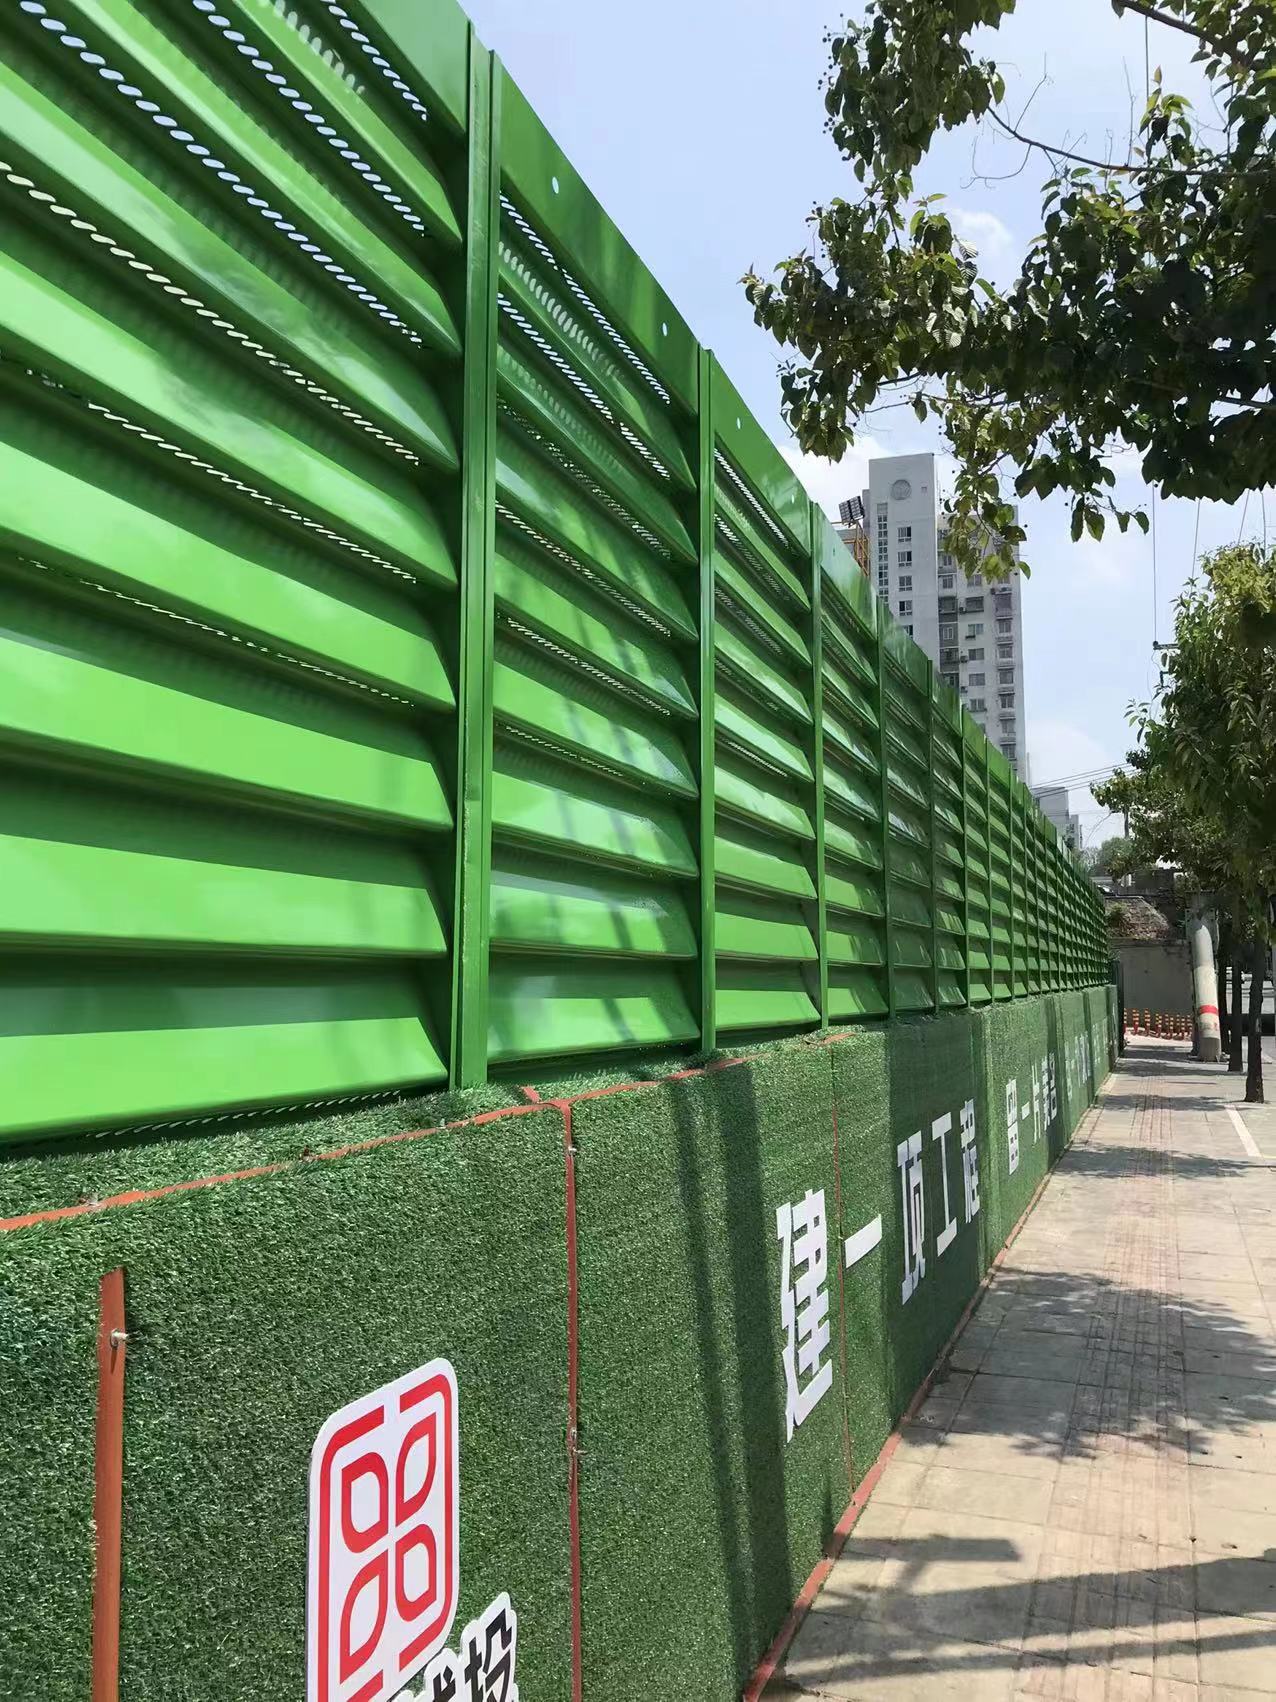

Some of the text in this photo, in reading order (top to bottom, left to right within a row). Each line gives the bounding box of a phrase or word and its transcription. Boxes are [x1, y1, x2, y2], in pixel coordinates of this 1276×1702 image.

[776, 1099, 980, 1442] 建一项工程
